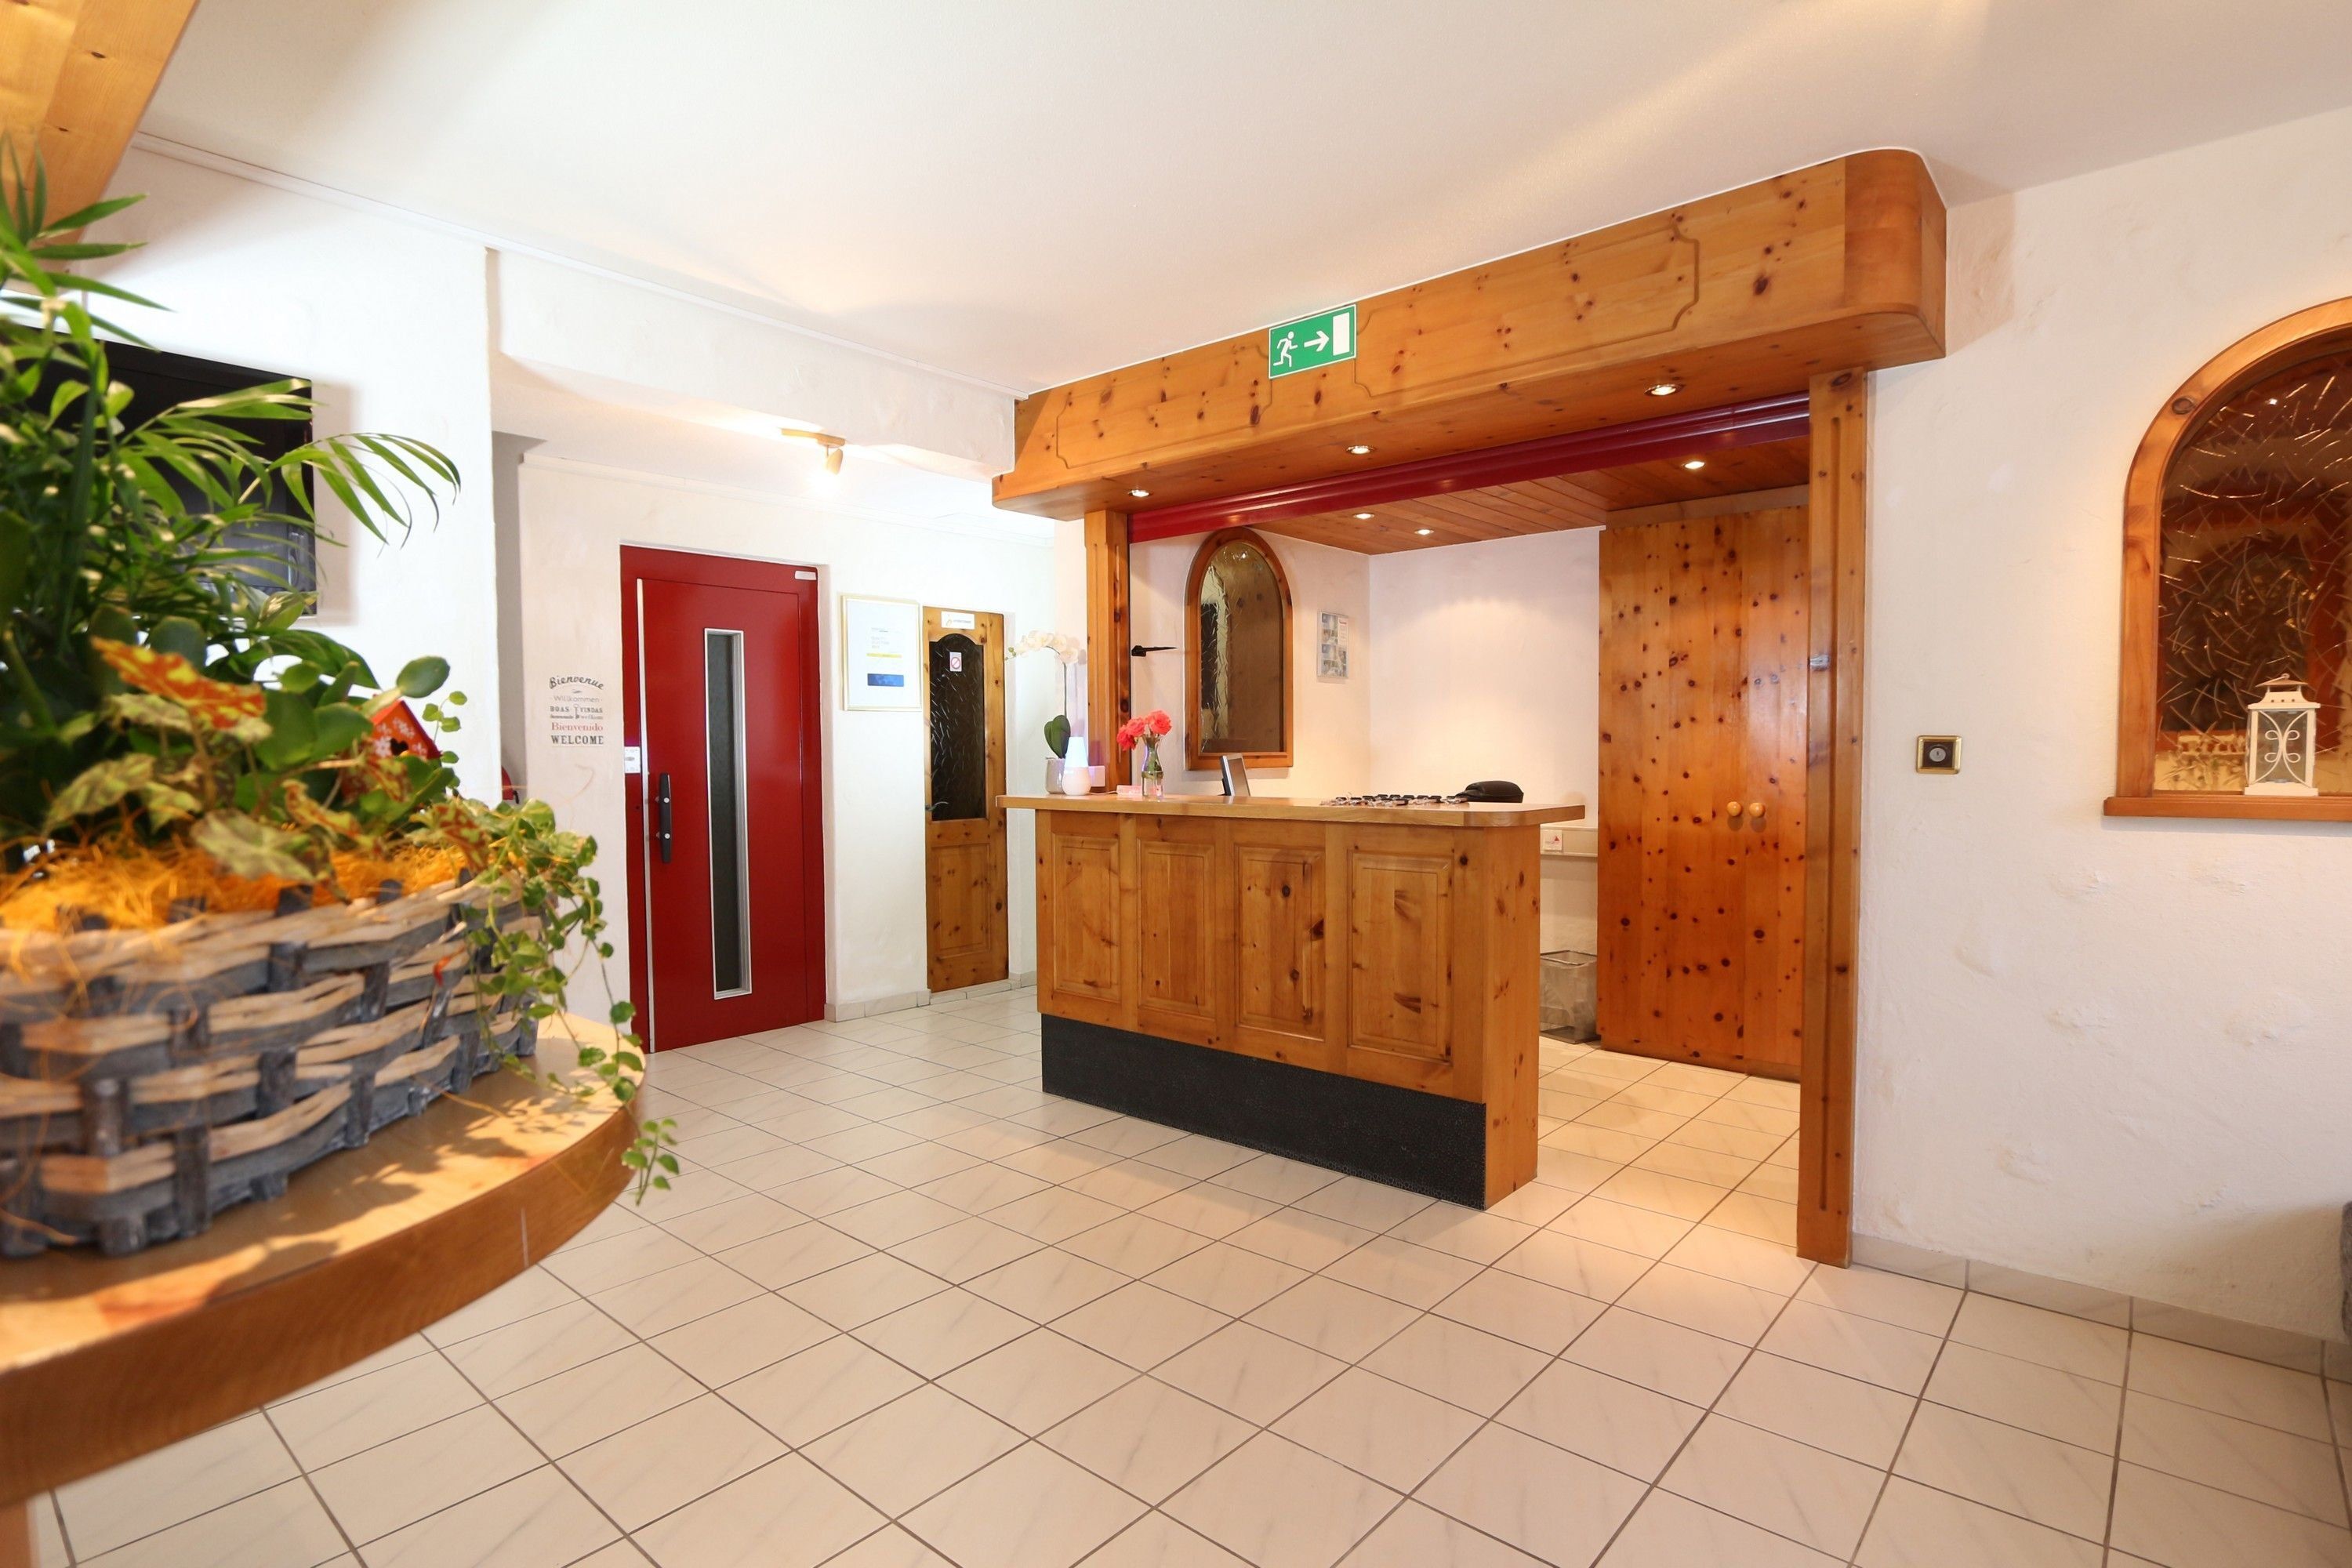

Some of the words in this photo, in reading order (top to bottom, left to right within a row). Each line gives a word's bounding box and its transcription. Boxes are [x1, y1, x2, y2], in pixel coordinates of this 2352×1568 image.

[549, 676, 604, 690] Bienvenue
[551, 722, 603, 731] Bienvenido
[550, 735, 604, 745] WELCOME
